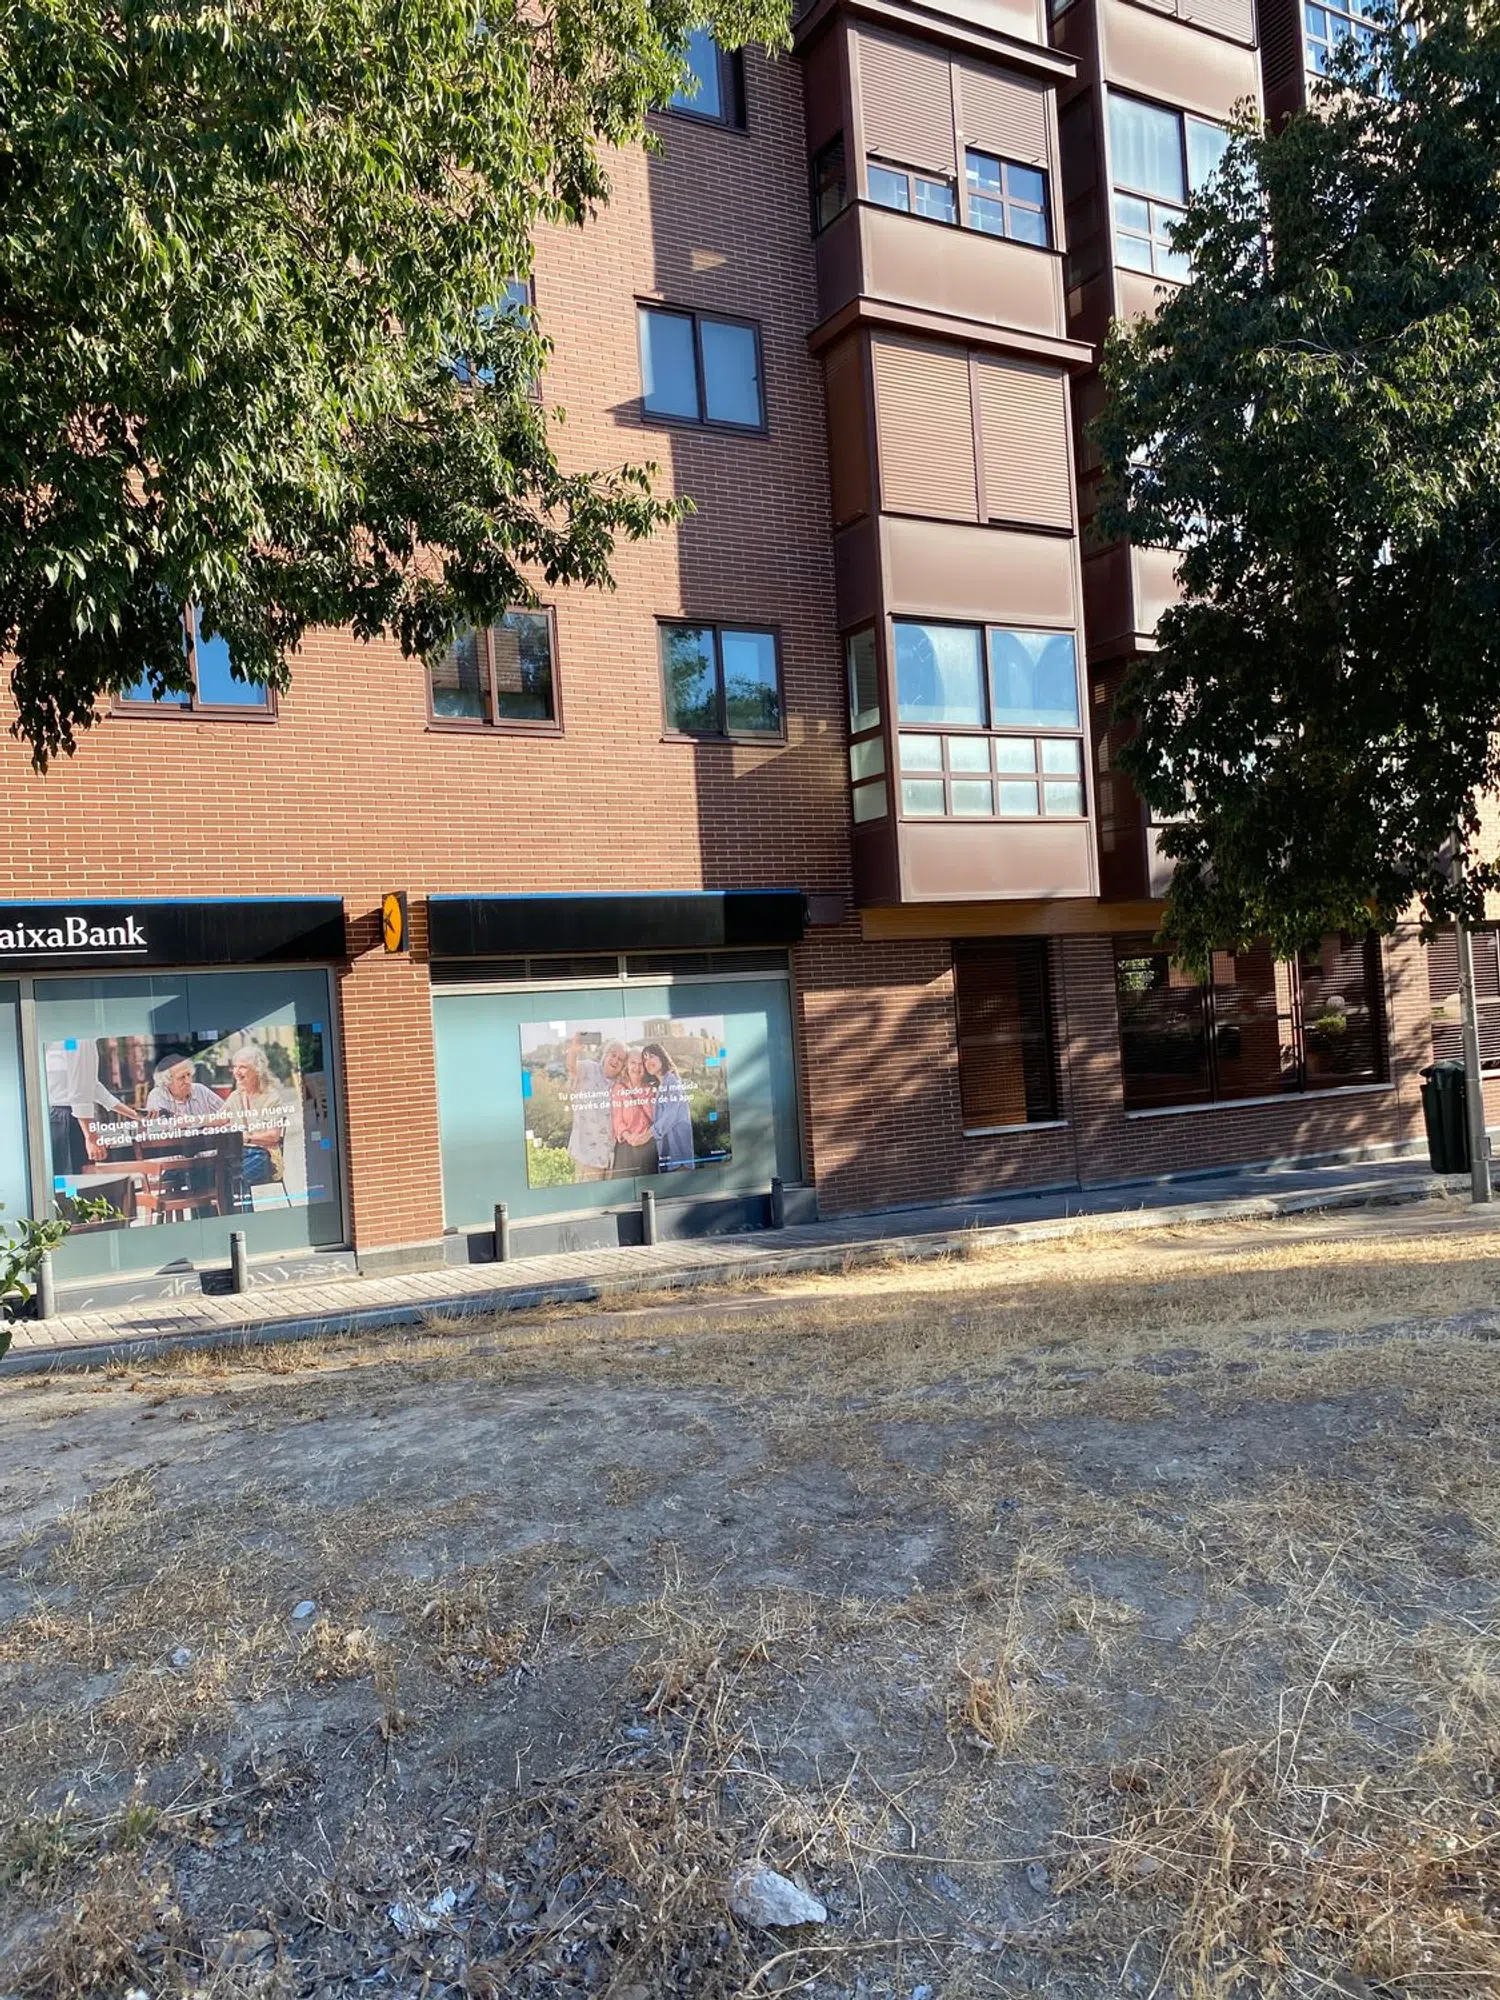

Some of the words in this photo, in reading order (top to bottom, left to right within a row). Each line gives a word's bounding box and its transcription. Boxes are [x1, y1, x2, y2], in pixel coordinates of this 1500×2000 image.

[0, 915, 147, 949] aixaBank
[558, 1091, 568, 1101] Tu
[617, 1086, 643, 1097] rápido
[645, 1086, 651, 1096] y
[658, 1084, 668, 1092] tu
[669, 1081, 699, 1091] medida
[571, 1101, 599, 1111] través
[600, 1101, 611, 1109] de
[612, 1100, 622, 1108] tu
[623, 1097, 649, 1108] gestor
[658, 1094, 668, 1103] de
[669, 1094, 678, 1102] la
[678, 1094, 695, 1103] app
[88, 1120, 138, 1133] Bloquea
[142, 1118, 153, 1127] tu
[157, 1114, 195, 1127] tarjeta
[198, 1114, 205, 1123] y
[209, 1109, 234, 1120] pide
[237, 1108, 258, 1117] una
[261, 1104, 295, 1116] nueva
[96, 1133, 132, 1146] desde
[135, 1131, 146, 1142] el
[149, 1128, 181, 1141] móvil
[185, 1128, 199, 1137] en
[202, 1125, 228, 1135] caso
[231, 1122, 245, 1132] de
